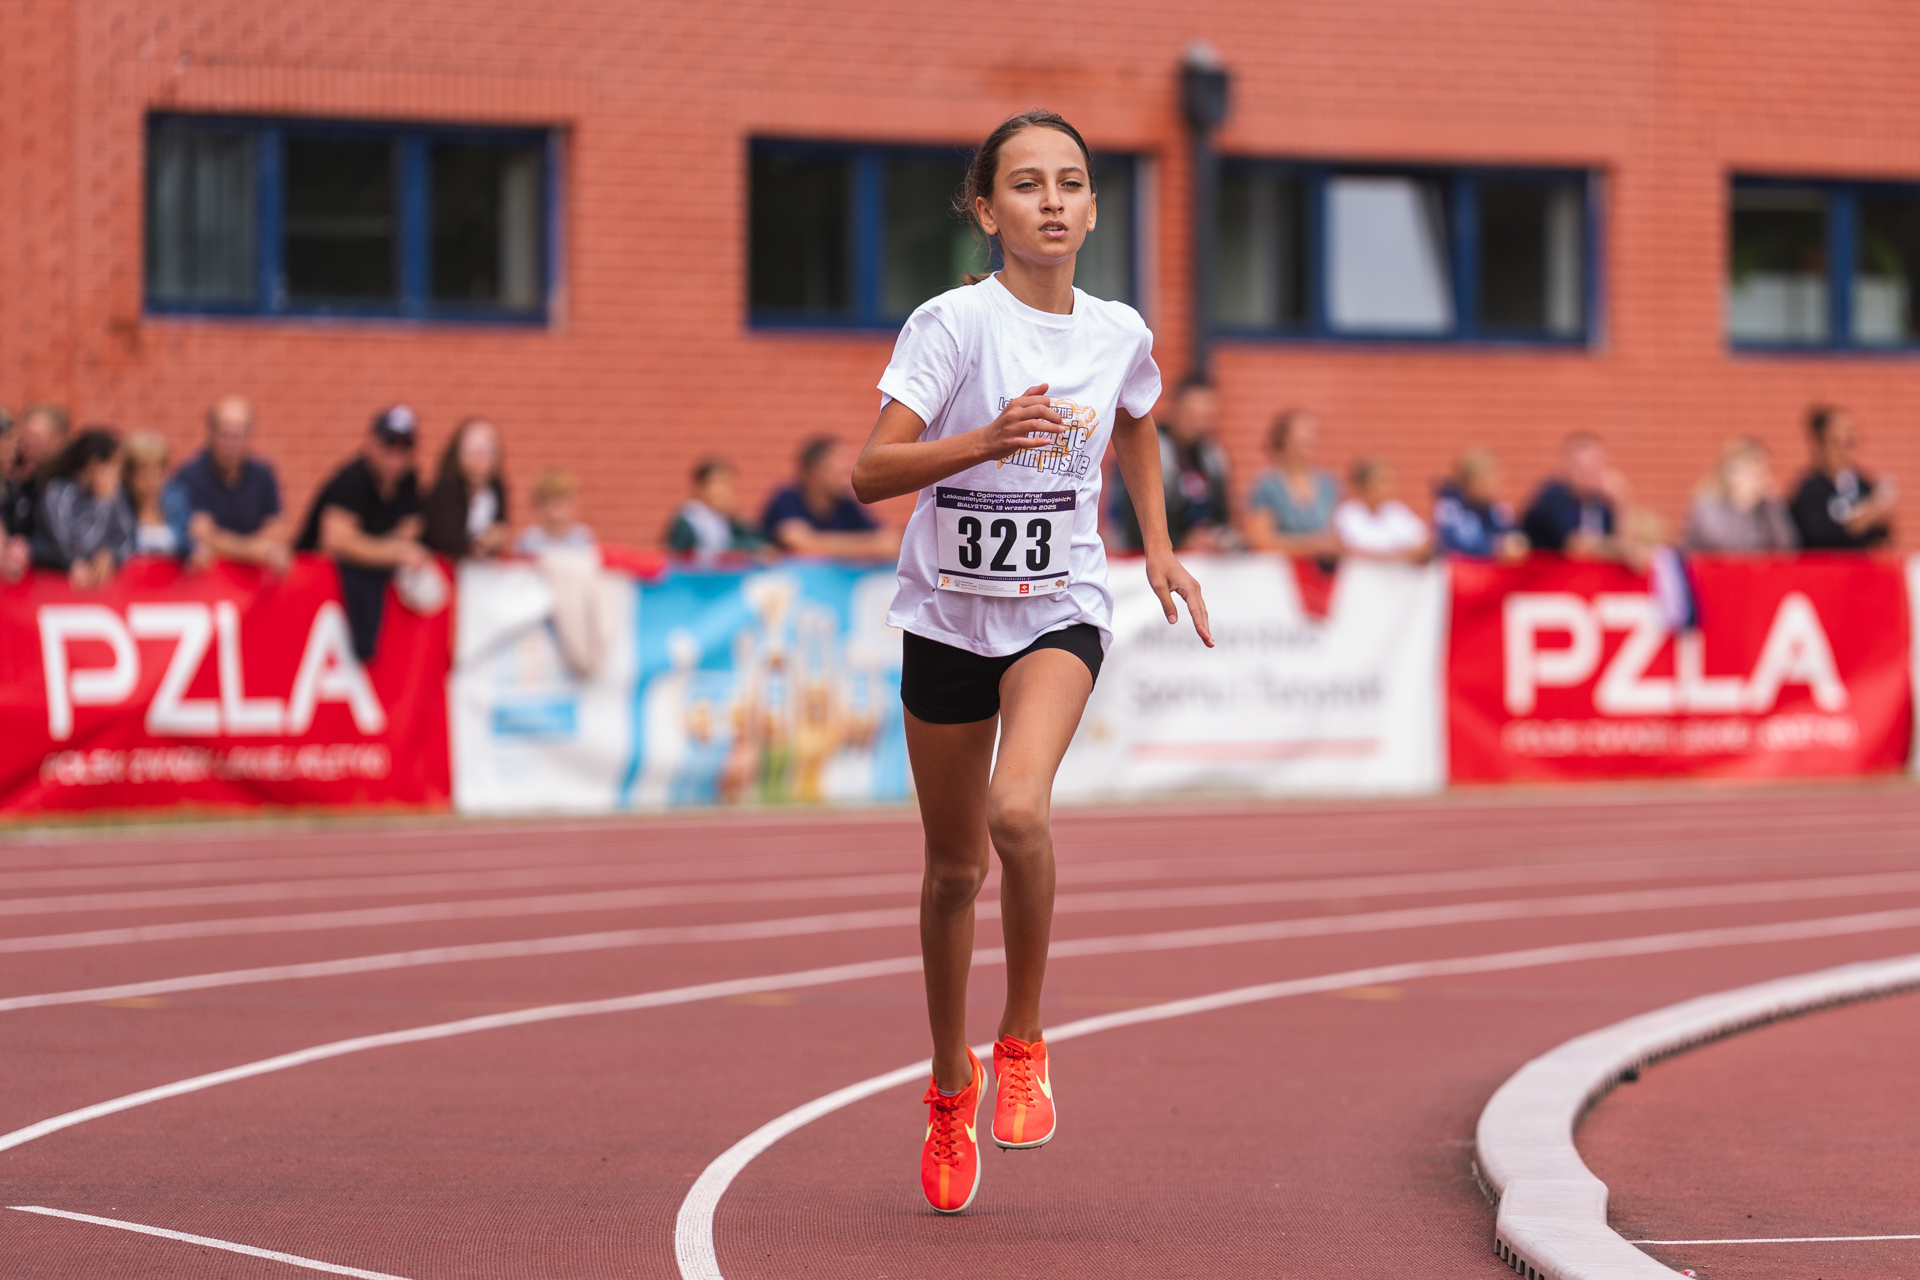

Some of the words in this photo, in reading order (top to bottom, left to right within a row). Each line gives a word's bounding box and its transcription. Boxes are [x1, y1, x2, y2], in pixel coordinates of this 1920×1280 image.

[942, 493, 1005, 504] Lekkoatletycznych
[1033, 496, 1072, 504] Olimpijskich
[958, 516, 1052, 572] 323
[39, 602, 386, 740] PZLA
[1505, 593, 1846, 713] PZLA
